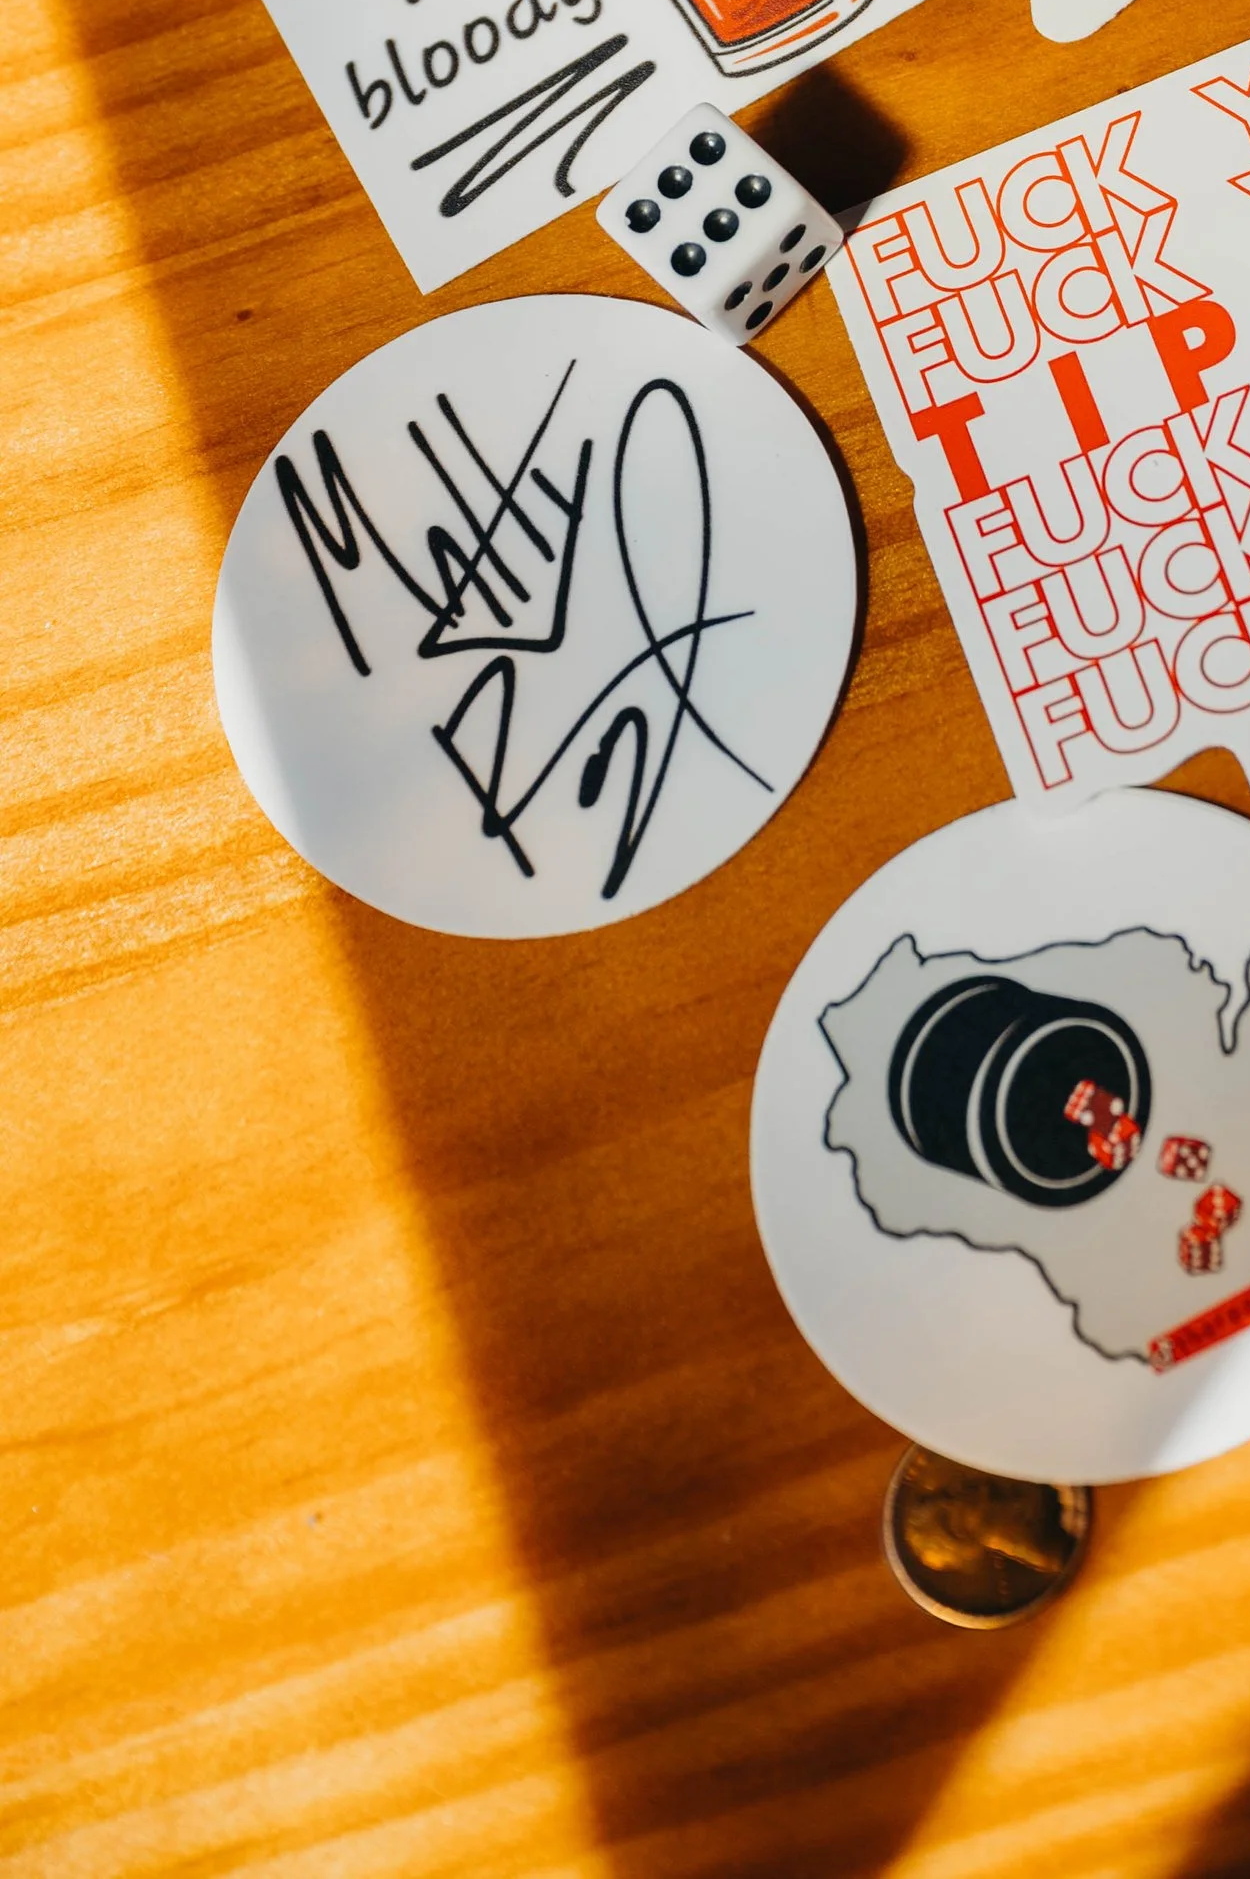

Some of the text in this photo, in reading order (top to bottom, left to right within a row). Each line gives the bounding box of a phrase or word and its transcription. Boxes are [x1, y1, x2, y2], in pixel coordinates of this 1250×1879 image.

[846, 111, 1177, 325] FUCK
[879, 204, 1212, 415] FUCK
[911, 299, 1237, 505] TIP
